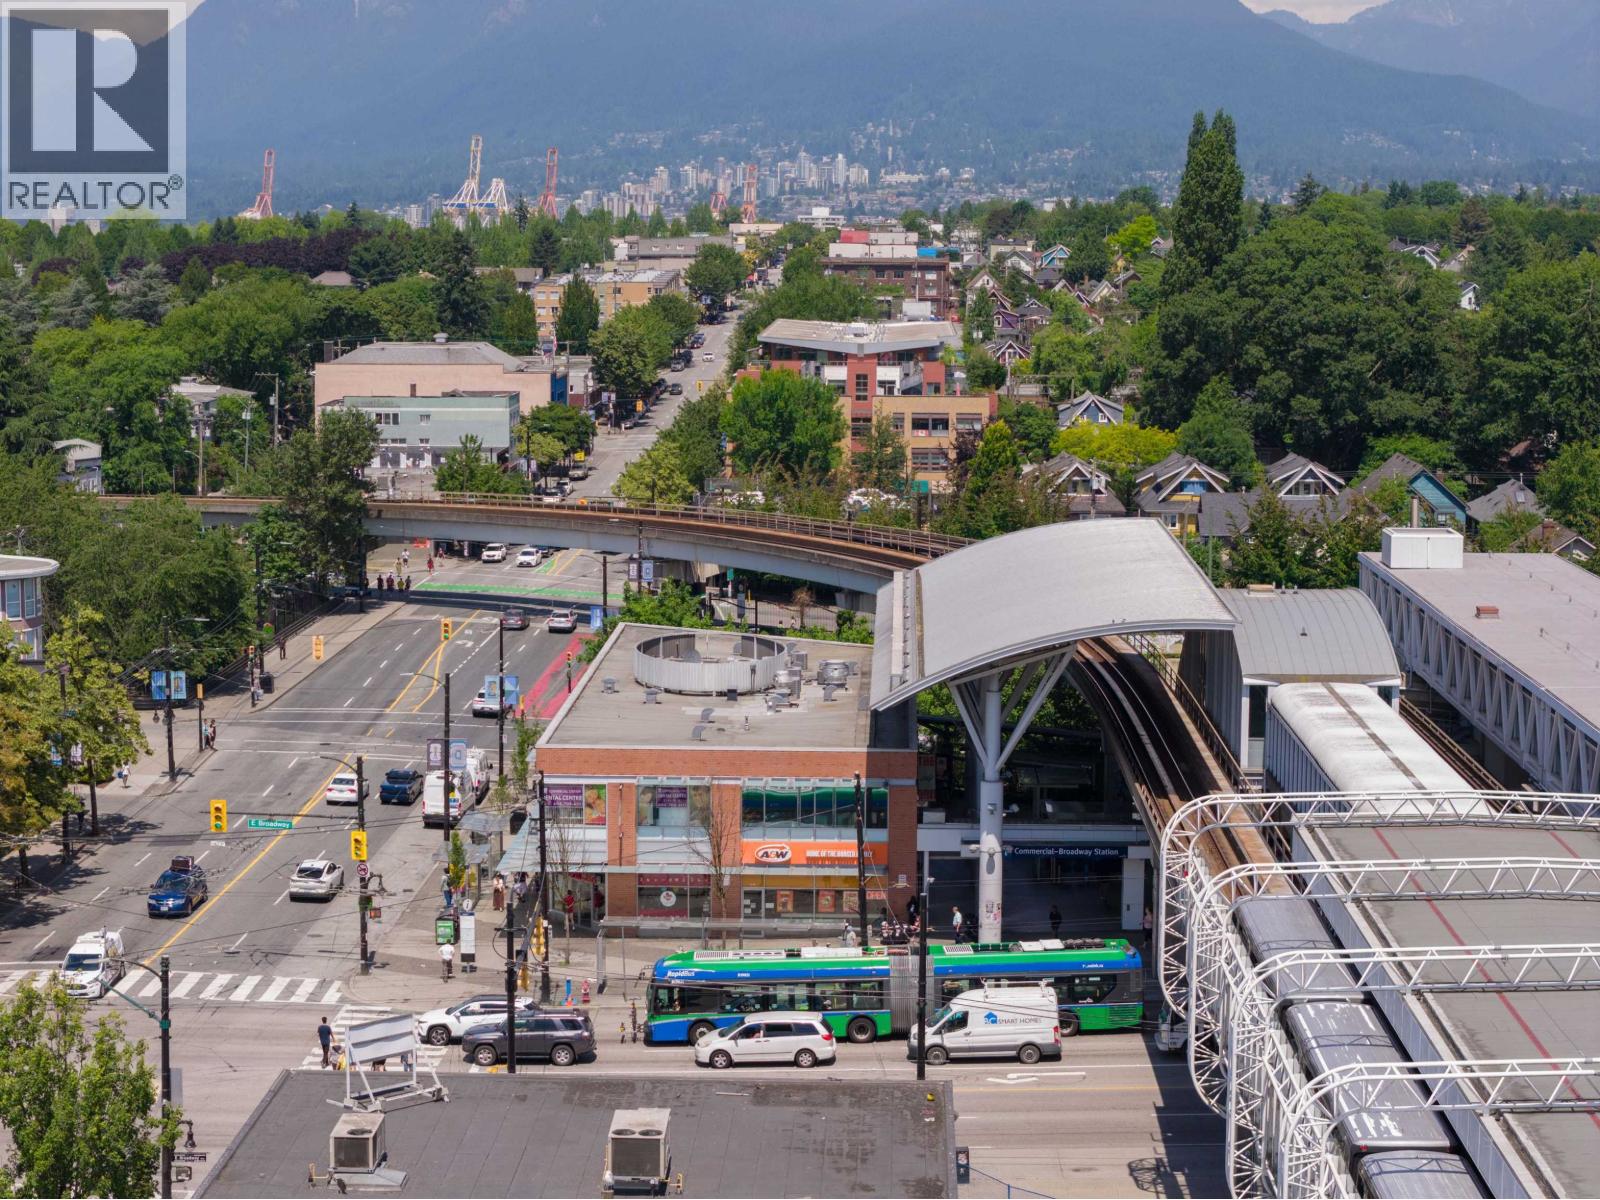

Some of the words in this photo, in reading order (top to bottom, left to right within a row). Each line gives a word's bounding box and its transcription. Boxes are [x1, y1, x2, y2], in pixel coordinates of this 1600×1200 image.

[258, 820, 290, 829] Broadway
[760, 850, 789, 859] A&W
[1094, 848, 1119, 856] Station
[667, 969, 695, 978] RapidBus
[1019, 1017, 1043, 1025] HOMES
